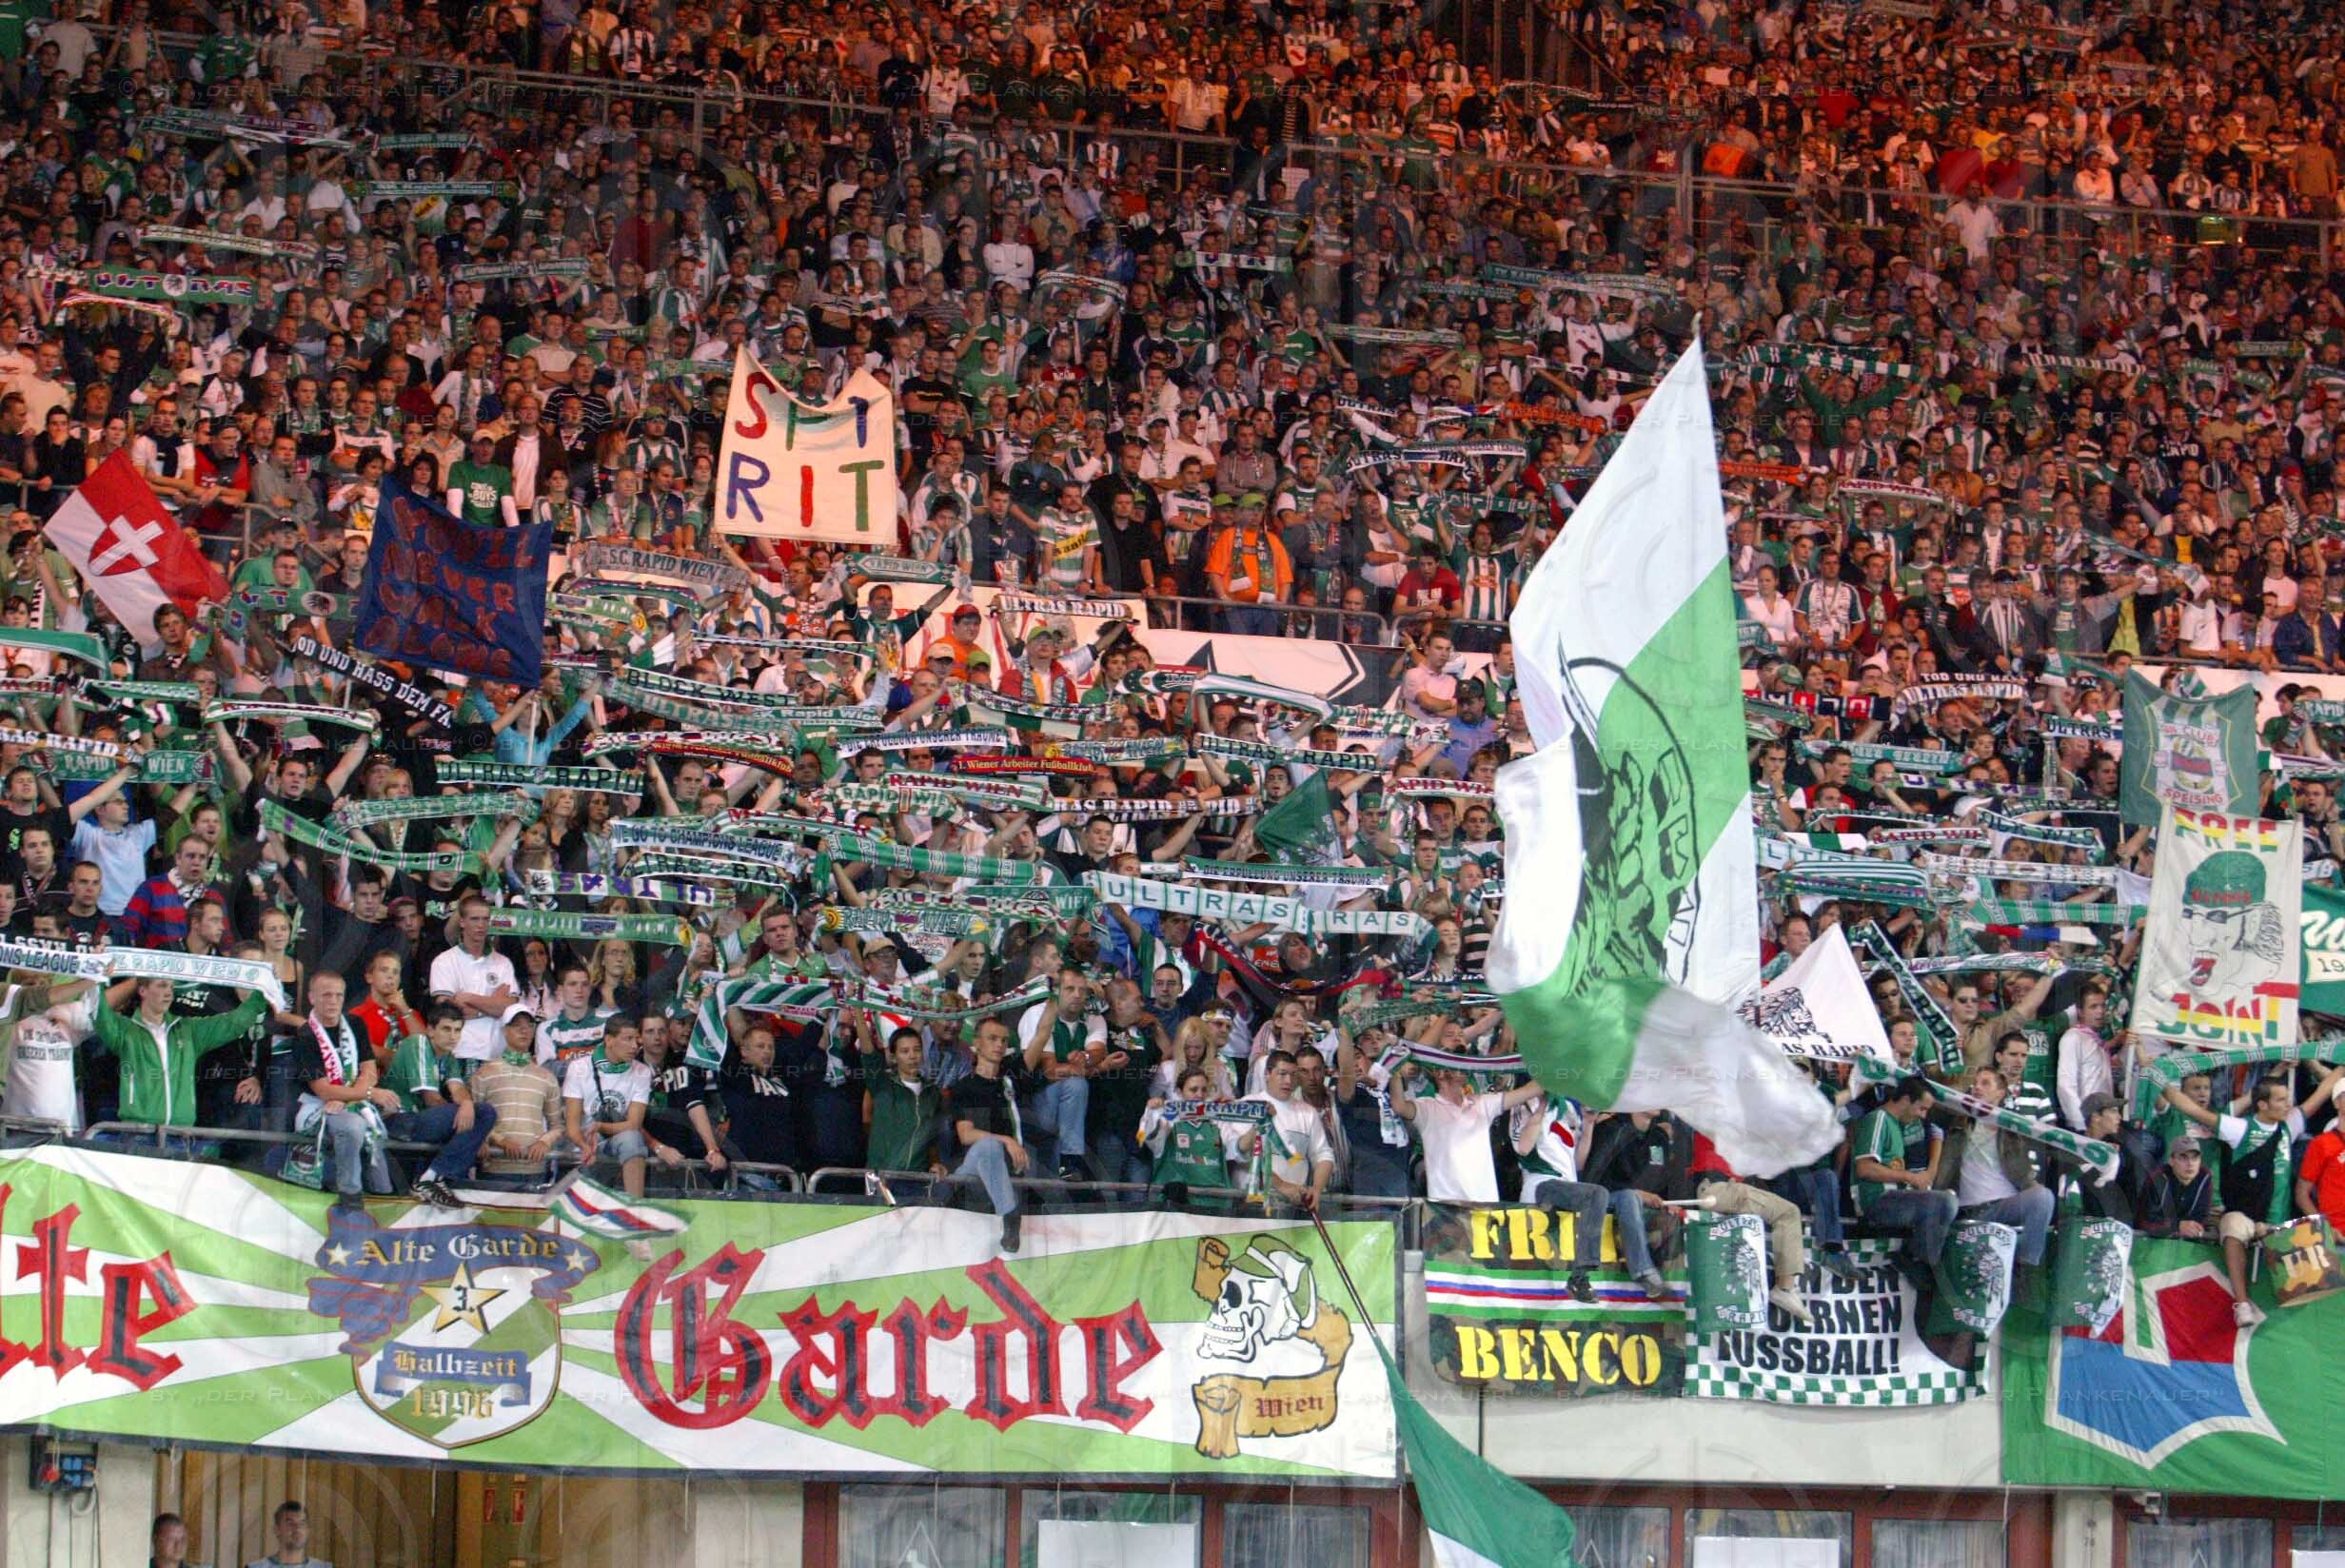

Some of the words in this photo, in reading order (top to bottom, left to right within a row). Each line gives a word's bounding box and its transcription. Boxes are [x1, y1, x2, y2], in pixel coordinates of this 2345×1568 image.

[94, 271, 253, 297] ULTRAS
[633, 549, 675, 571] RAPID
[680, 558, 717, 579] WIEN
[1001, 597, 1066, 615] ULTRAS
[1071, 599, 1126, 618] RAPID
[320, 646, 350, 671] UND
[352, 661, 395, 692] HASS
[396, 681, 433, 713] DEM
[431, 706, 451, 729] FA
[1903, 685, 1968, 705] ULTRAS
[1972, 683, 2024, 699] RAPID
[47, 732, 119, 758] RAPID
[1202, 735, 1276, 761] ULTRAS
[1304, 751, 1377, 770] RAPID
[64, 755, 109, 773] RAPID
[148, 755, 186, 773] WIEN
[967, 759, 999, 770] Wiener
[1001, 759, 1038, 770] Arbeiter
[843, 787, 899, 802] RAPID
[965, 779, 1021, 798] WIEN
[2164, 788, 2224, 805] SPEISING
[1103, 798, 1173, 811] RAPID
[1872, 830, 1936, 844] RAPID
[2172, 807, 2278, 852] FREE
[631, 824, 648, 842] GO
[653, 825, 666, 843] TO
[670, 827, 737, 851] CHAMPIONS
[737, 835, 783, 862] LEAGUE
[1055, 894, 1089, 910] WIE
[1108, 882, 1289, 917] ULTRAS
[1332, 911, 1409, 926] RAS
[27, 950, 79, 973] LEAGUE
[2158, 982, 2299, 1047] JOINT
[1781, 1042, 1803, 1054] AS
[355, 1240, 436, 1267] Alte
[447, 1232, 561, 1261] Garde
[612, 1240, 1166, 1435] Garde
[394, 1348, 518, 1379] Halbzeit
[1455, 1325, 1662, 1386] BENCO
[1718, 1330, 1900, 1375] FUSSBALL!
[411, 1386, 494, 1419] 1996
[1254, 1396, 1326, 1418] Wien
